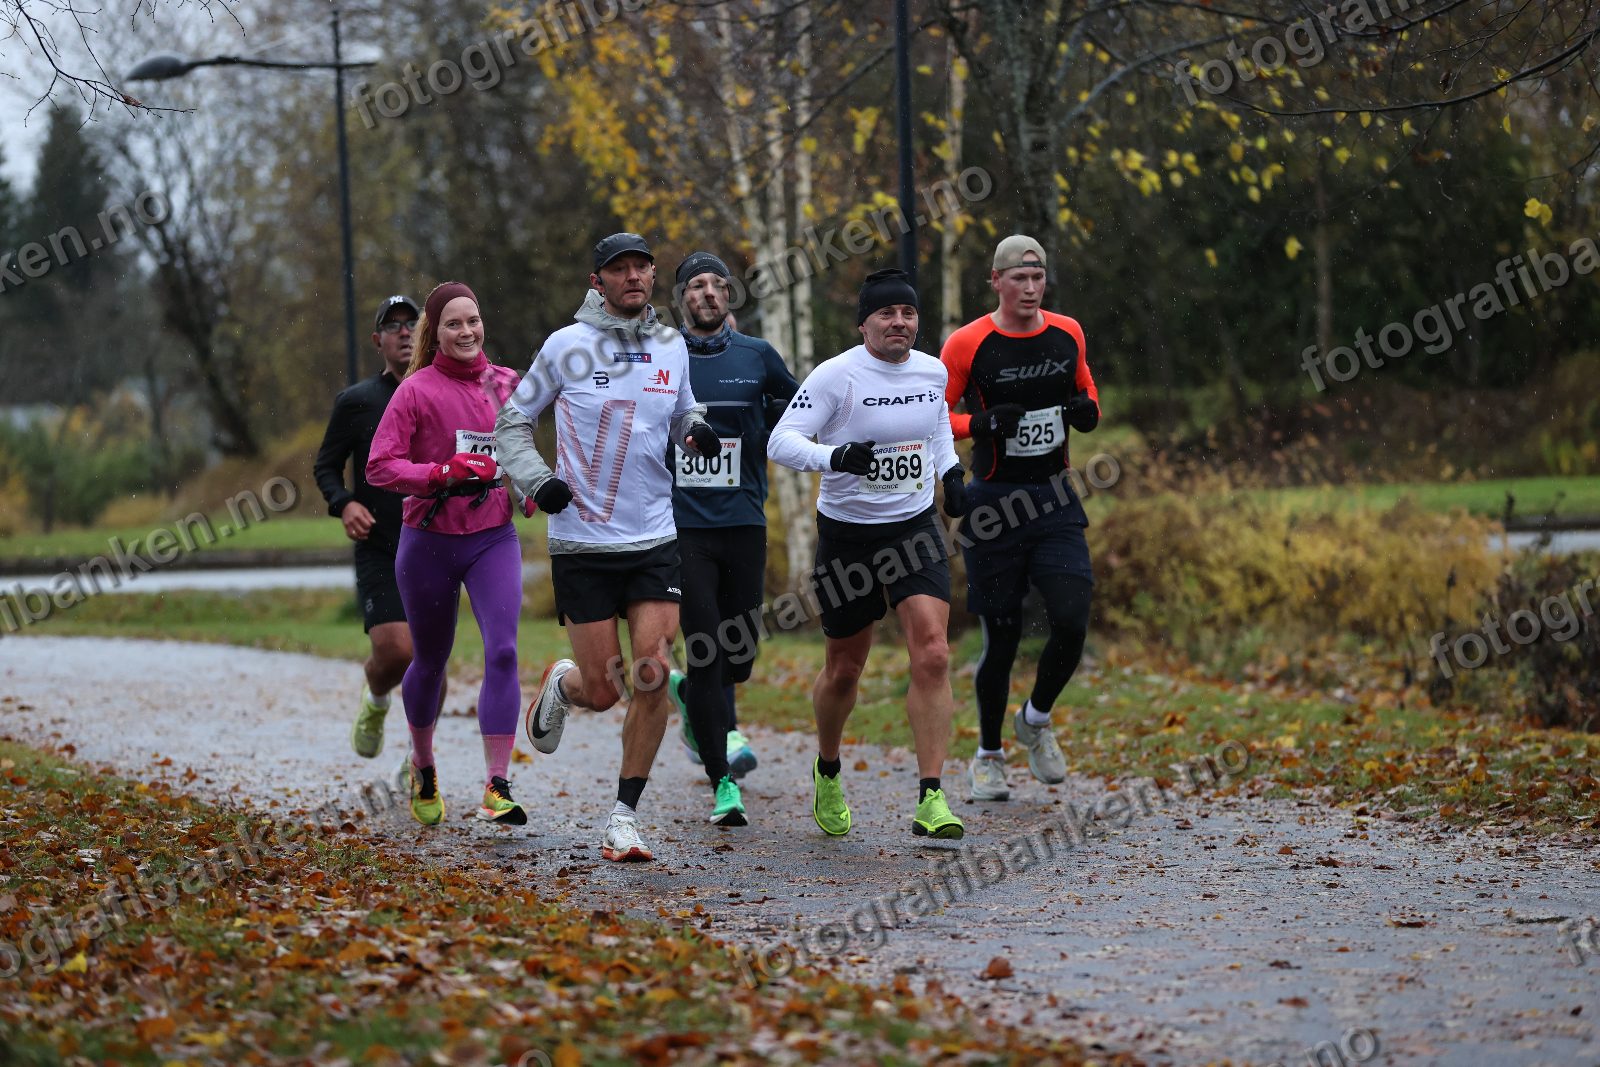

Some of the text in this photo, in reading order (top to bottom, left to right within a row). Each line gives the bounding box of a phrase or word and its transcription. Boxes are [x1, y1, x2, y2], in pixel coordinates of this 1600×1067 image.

[863, 393, 926, 406] CRAFT
[1018, 422, 1055, 447] 525
[872, 443, 923, 455] ORGESTESTEN
[681, 451, 733, 475] 3001
[865, 453, 922, 481] 9369
